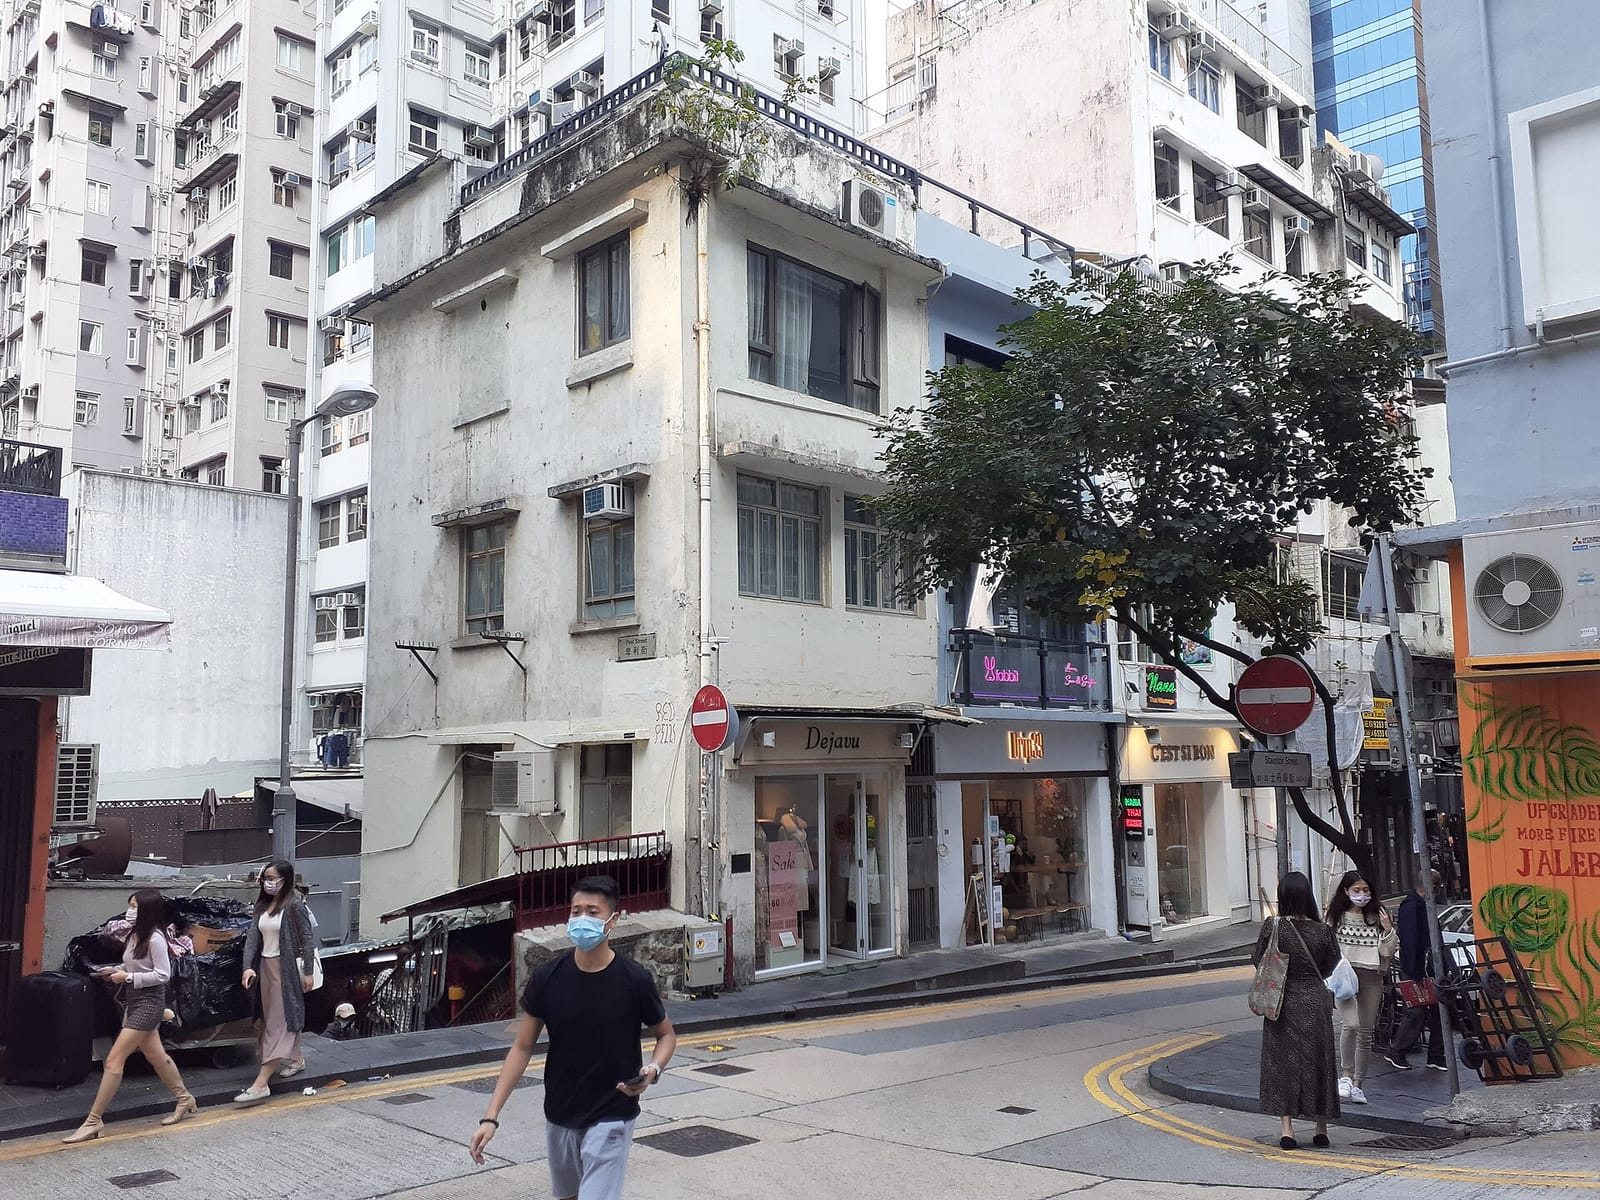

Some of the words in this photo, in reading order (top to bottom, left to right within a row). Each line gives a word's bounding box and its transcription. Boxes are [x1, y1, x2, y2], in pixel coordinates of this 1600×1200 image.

[95, 623, 139, 636] SOHO
[1147, 672, 1176, 694] Nana
[806, 726, 860, 755] Dejavu
[1008, 730, 1044, 765] Drip33
[1193, 744, 1216, 762] BON
[1264, 755, 1284, 765] Staunton
[1285, 756, 1298, 765] Street
[1126, 808, 1142, 817] THAI
[1516, 826, 1554, 841] MORE
[1557, 827, 1596, 843] FIRE
[771, 851, 796, 872] Sale
